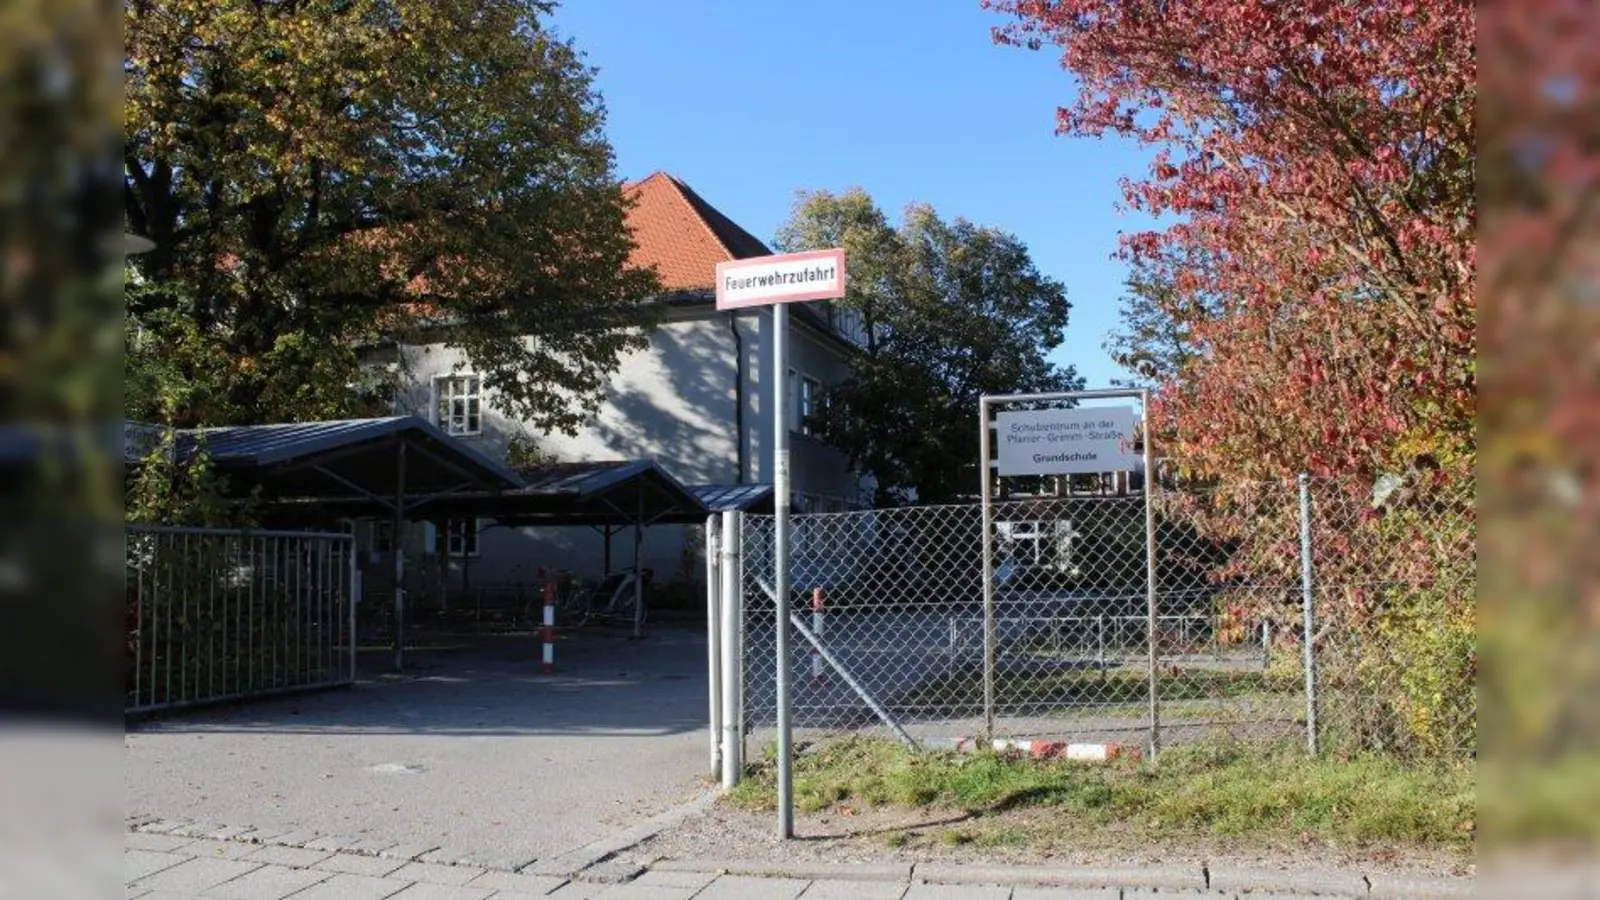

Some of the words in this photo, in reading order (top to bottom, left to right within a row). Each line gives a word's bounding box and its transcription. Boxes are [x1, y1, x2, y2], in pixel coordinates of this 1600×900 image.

[725, 266, 835, 290] Feuerwehrzufahrt
[1011, 422, 1080, 432] Schulzentrum
[1083, 421, 1095, 430] an
[1097, 420, 1114, 428] der
[1033, 452, 1098, 463] Grundschule
